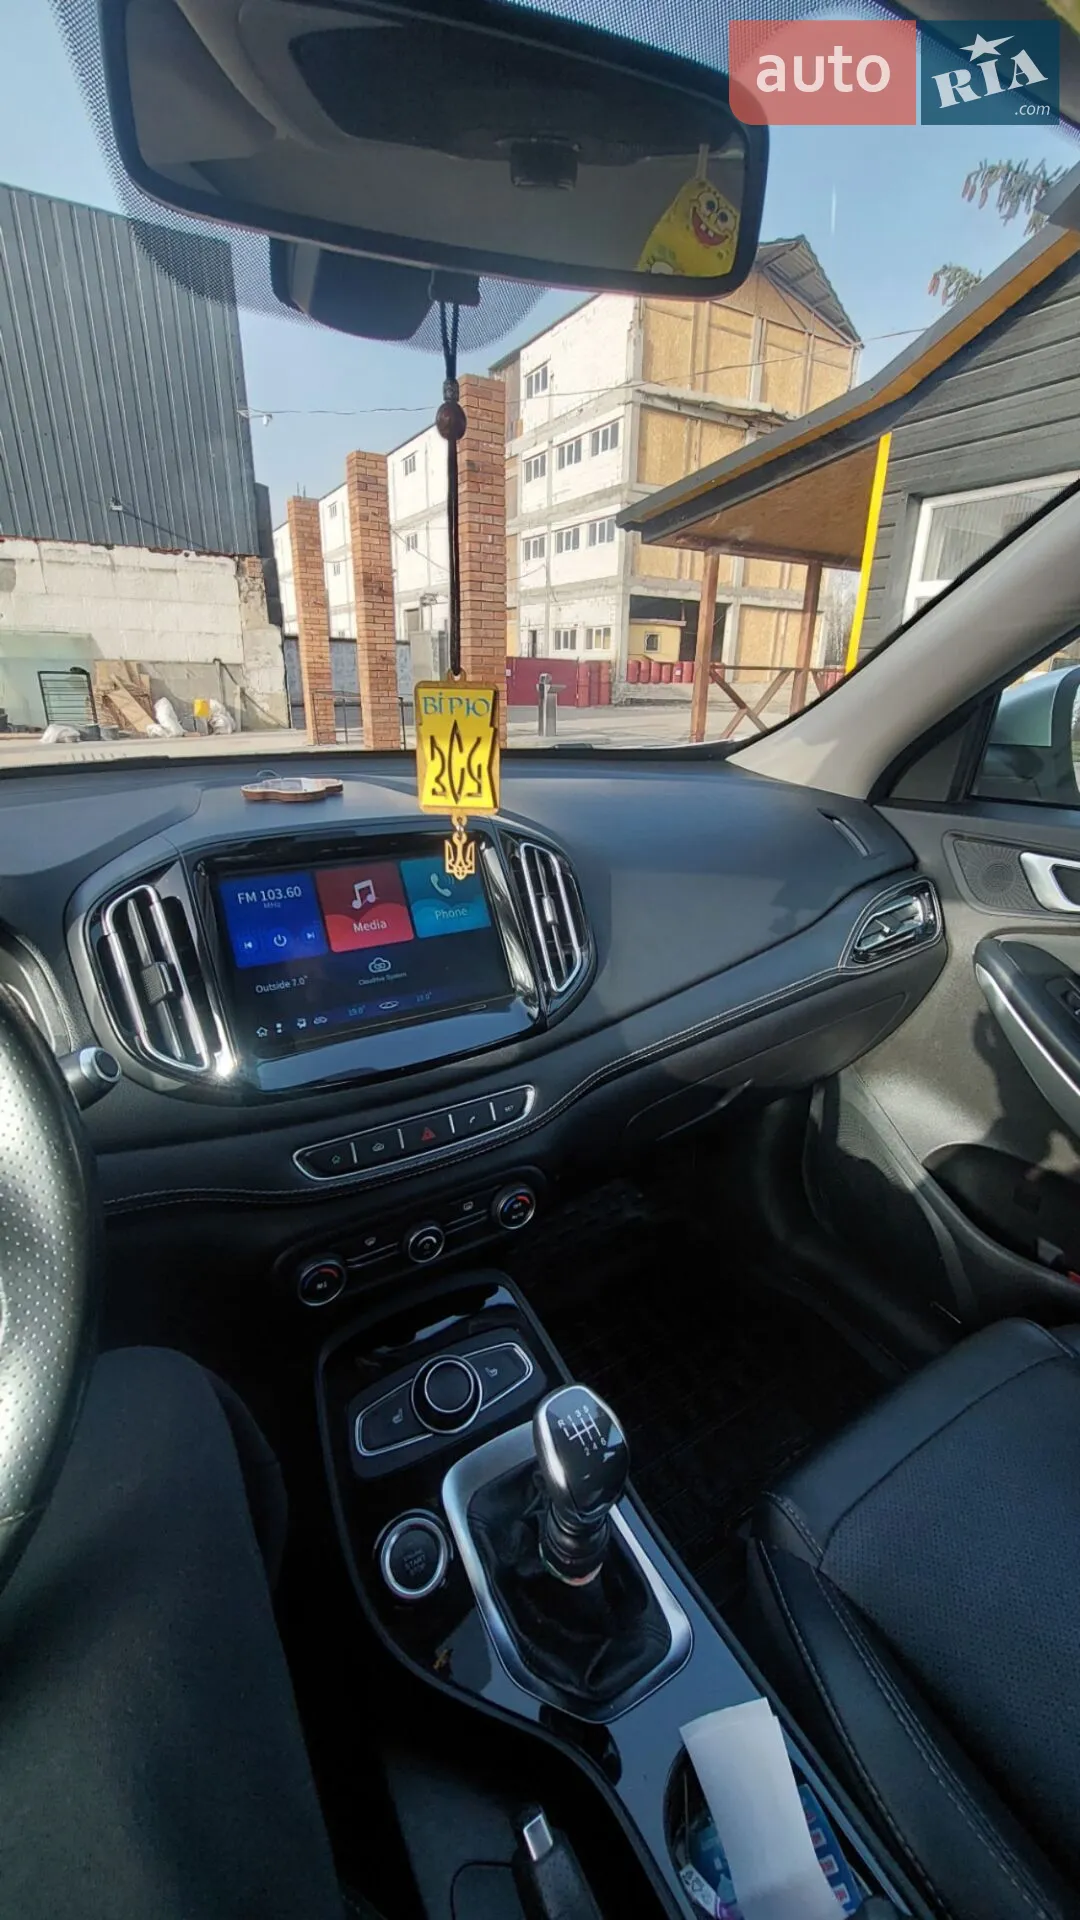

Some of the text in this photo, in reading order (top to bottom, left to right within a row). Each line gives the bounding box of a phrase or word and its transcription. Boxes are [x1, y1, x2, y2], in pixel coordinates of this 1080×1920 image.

[237, 886, 302, 904] FM 103.60
[434, 907, 468, 921] Phone
[353, 919, 388, 933] Media
[255, 979, 290, 993] Outside
[557, 1419, 565, 1428] R
[567, 1414, 573, 1422] 1
[575, 1408, 582, 1418] 3
